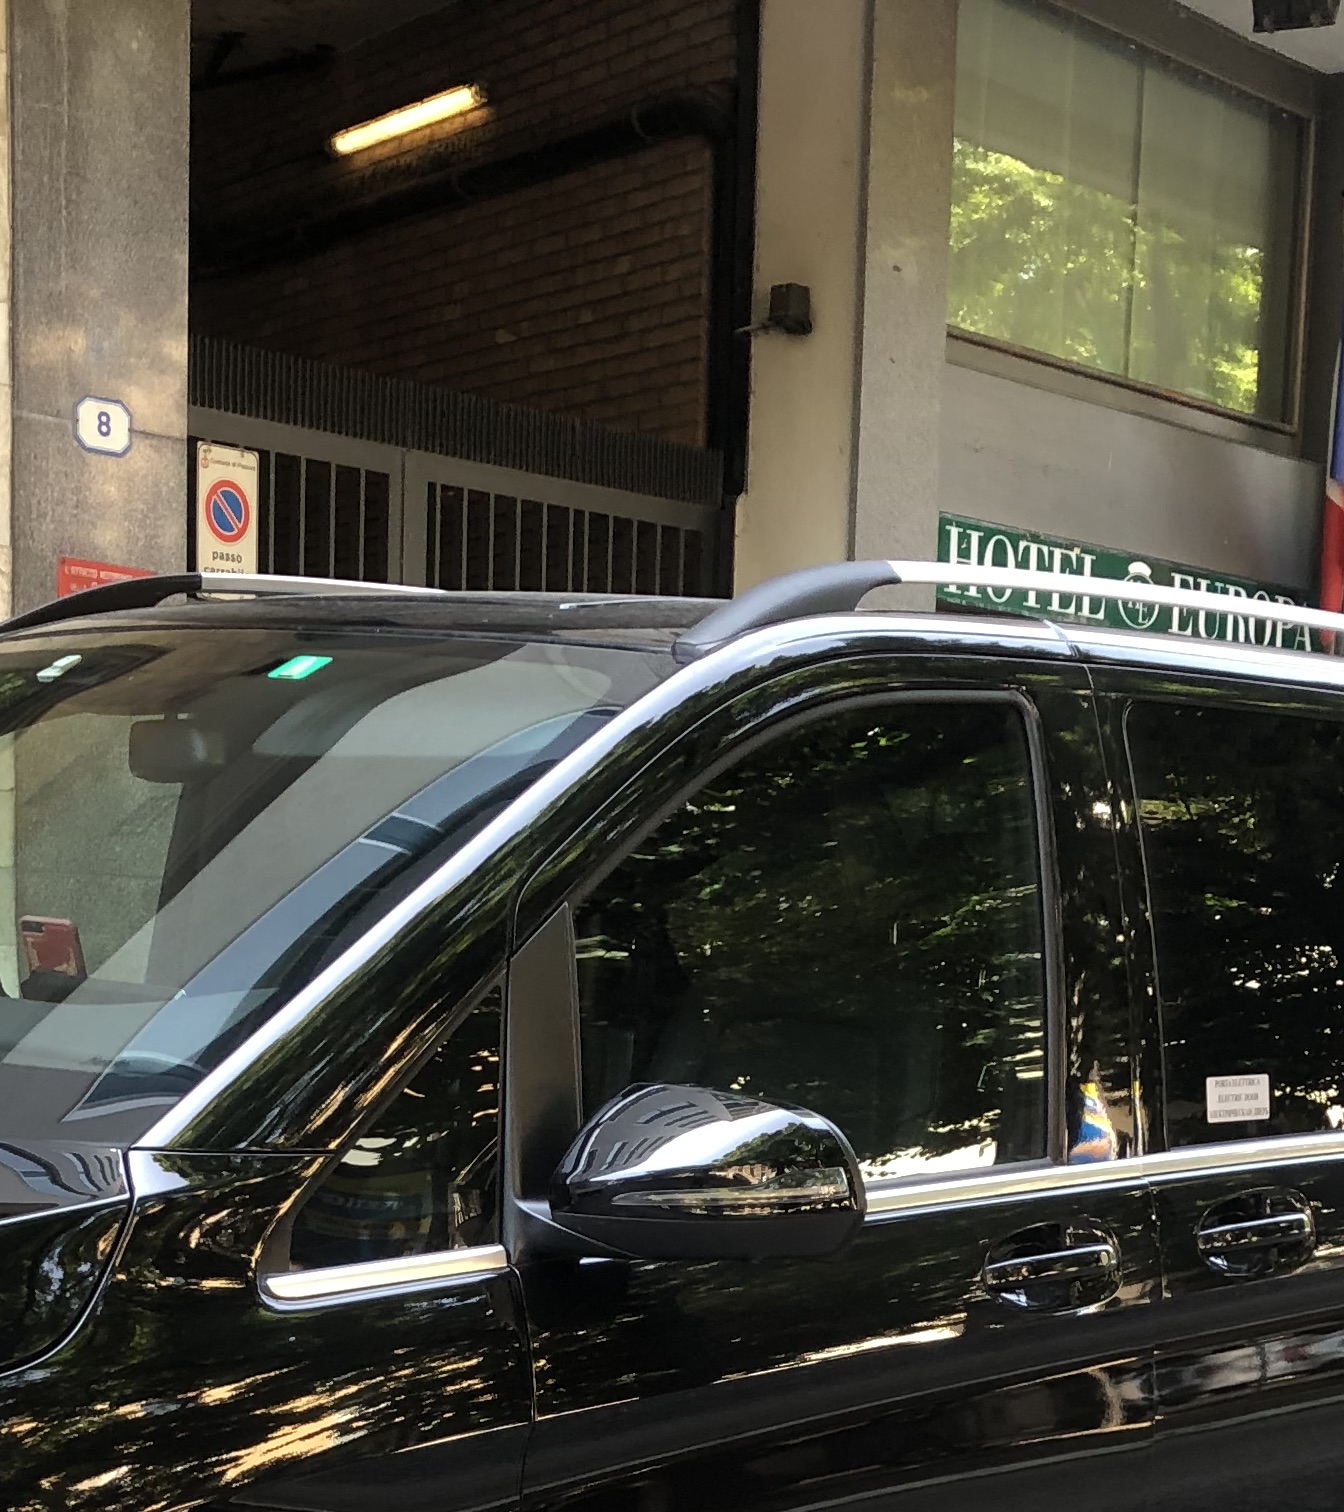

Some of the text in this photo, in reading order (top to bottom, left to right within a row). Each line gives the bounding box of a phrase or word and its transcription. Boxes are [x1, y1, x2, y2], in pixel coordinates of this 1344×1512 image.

[97, 411, 111, 437] 8
[212, 550, 243, 563] passo
[944, 523, 1312, 652] HOTEL EUROPA
